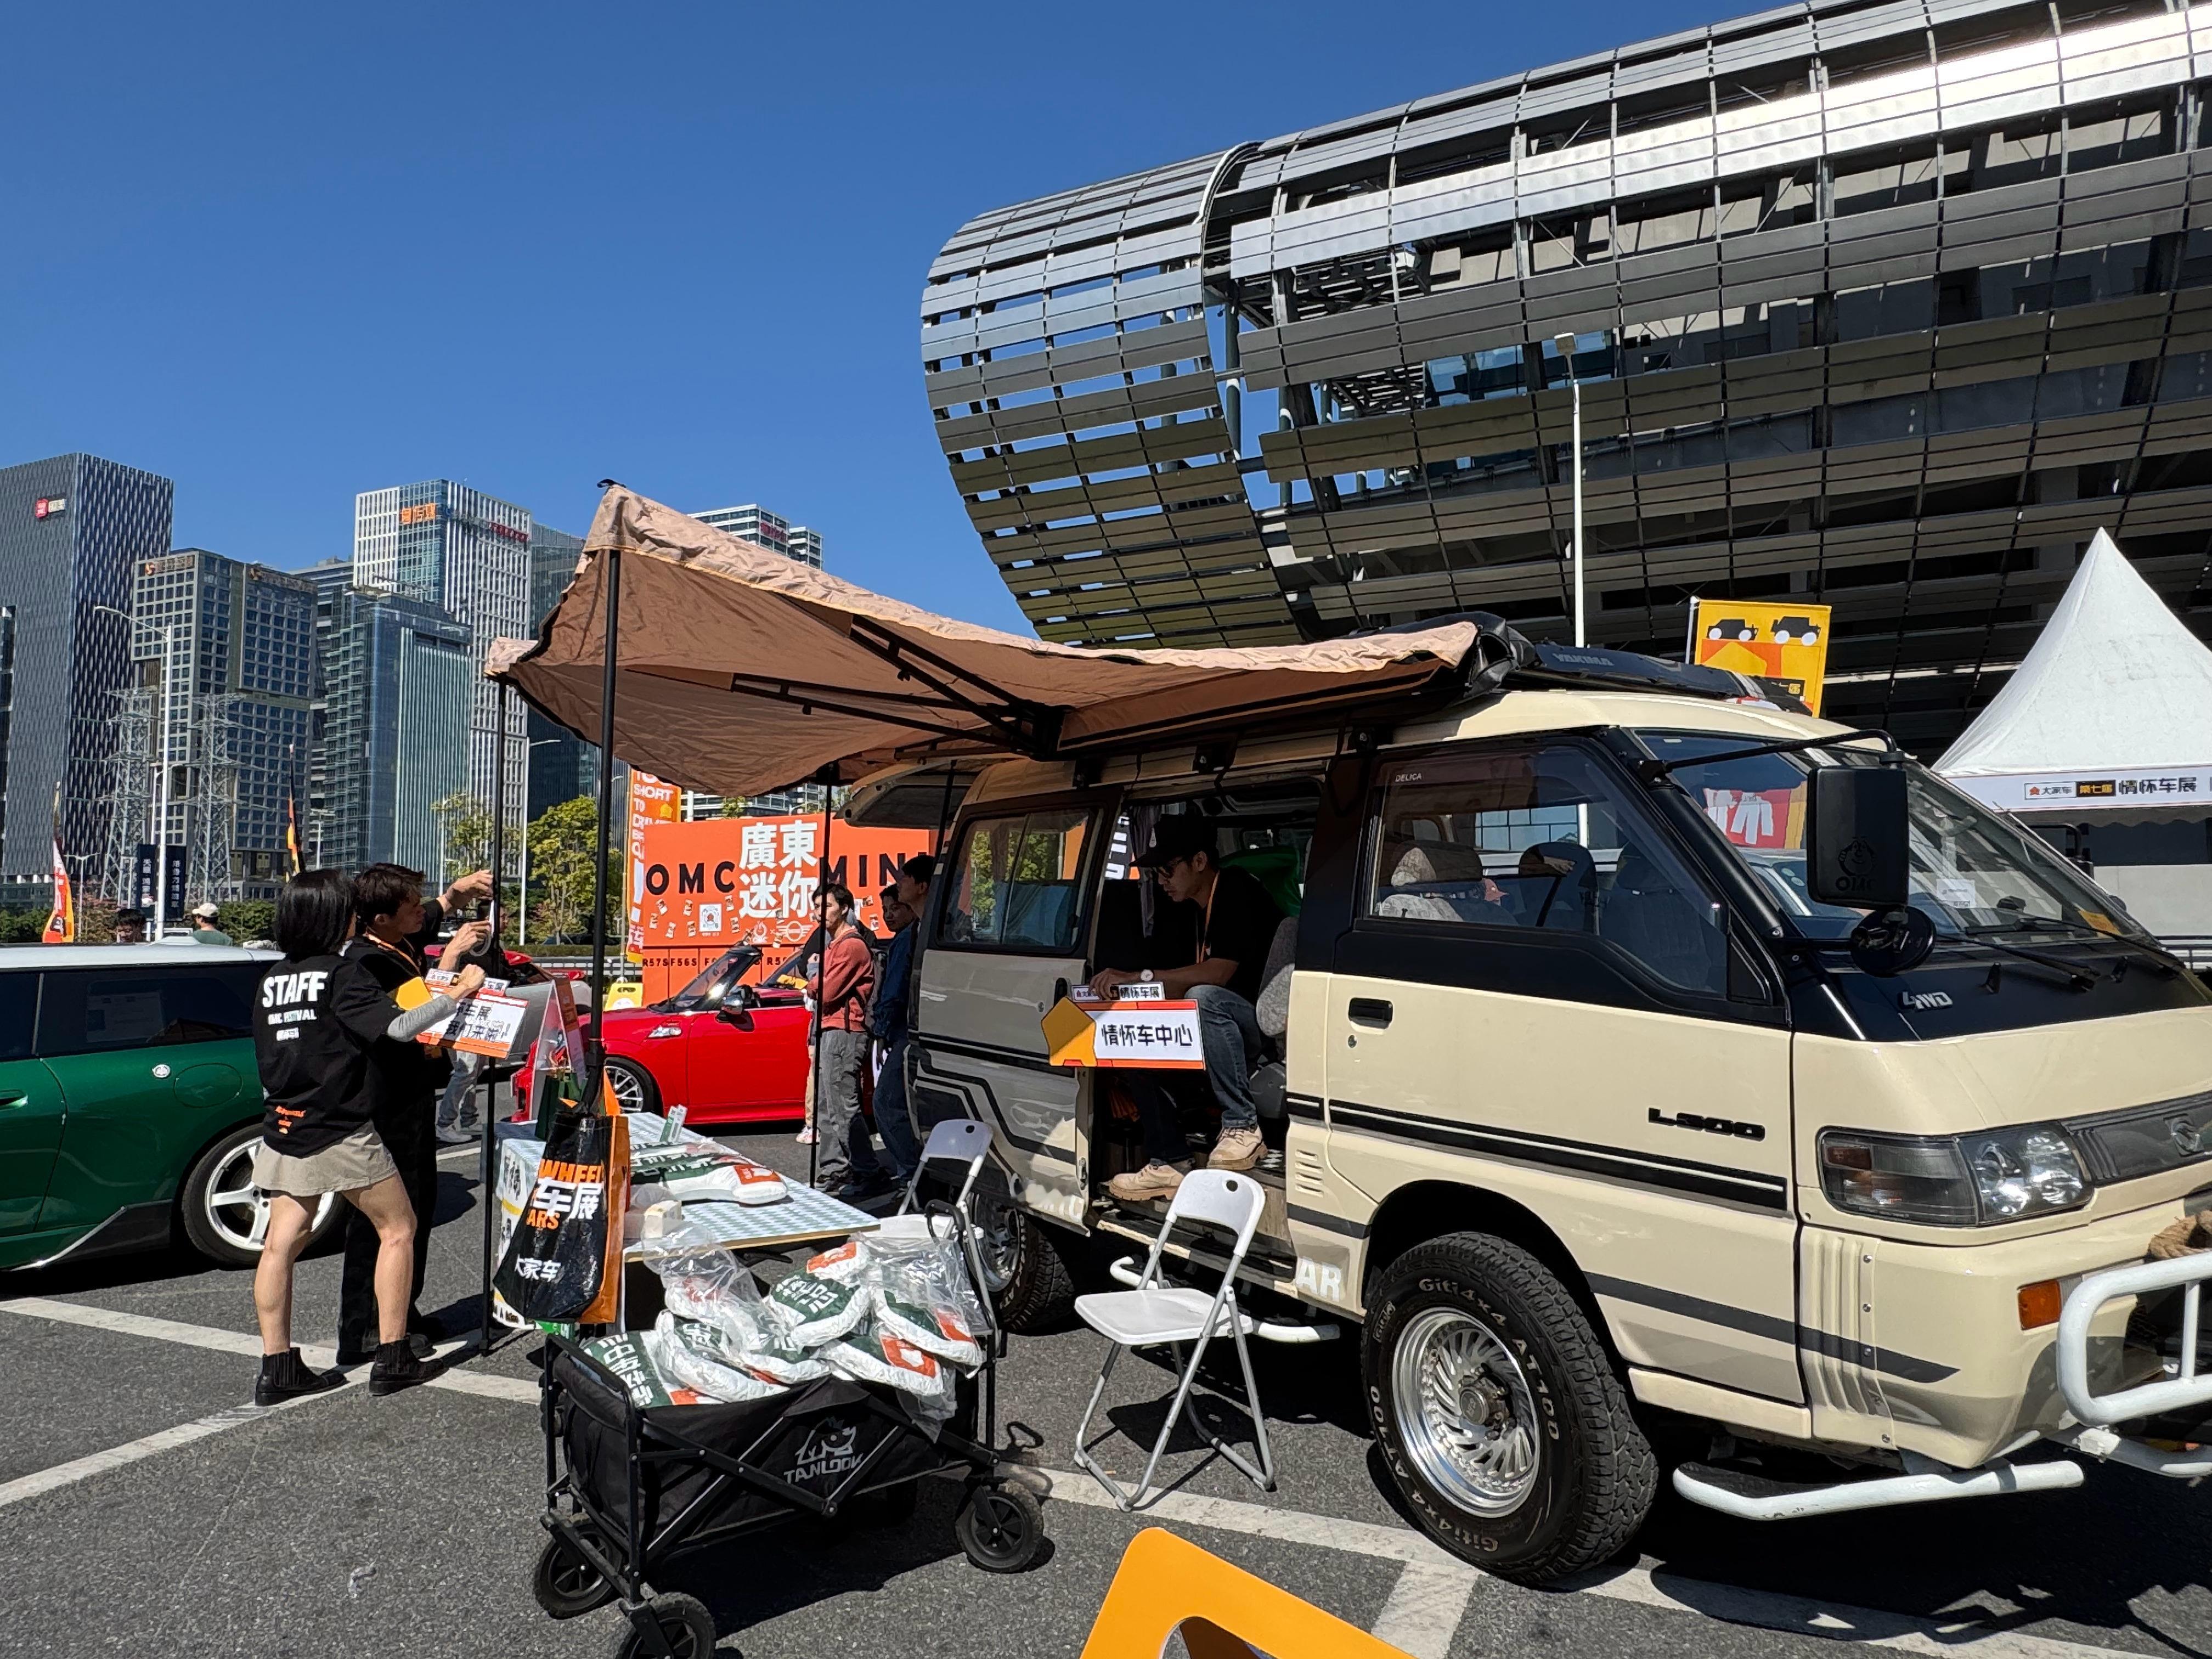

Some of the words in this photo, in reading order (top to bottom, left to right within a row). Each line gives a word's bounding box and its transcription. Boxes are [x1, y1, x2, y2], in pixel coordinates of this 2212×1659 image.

[1552, 653, 1615, 666] YAKIMA
[1395, 772, 1422, 782] DELICA
[2119, 777, 2197, 795] 情怀车展
[634, 784, 675, 802] SHORT
[739, 820, 818, 870] 廣東
[646, 861, 736, 896] OMC
[819, 852, 927, 887] MIN
[738, 870, 819, 919] 迷你
[642, 958, 668, 967] R57S
[670, 958, 697, 966] F56S
[262, 971, 329, 1008] STAFF
[1119, 985, 1160, 998] 情怀车展
[1902, 991, 1954, 1010] 4WD
[1101, 1024, 1193, 1047] 情怀车中心
[530, 1177, 603, 1221] 车展
